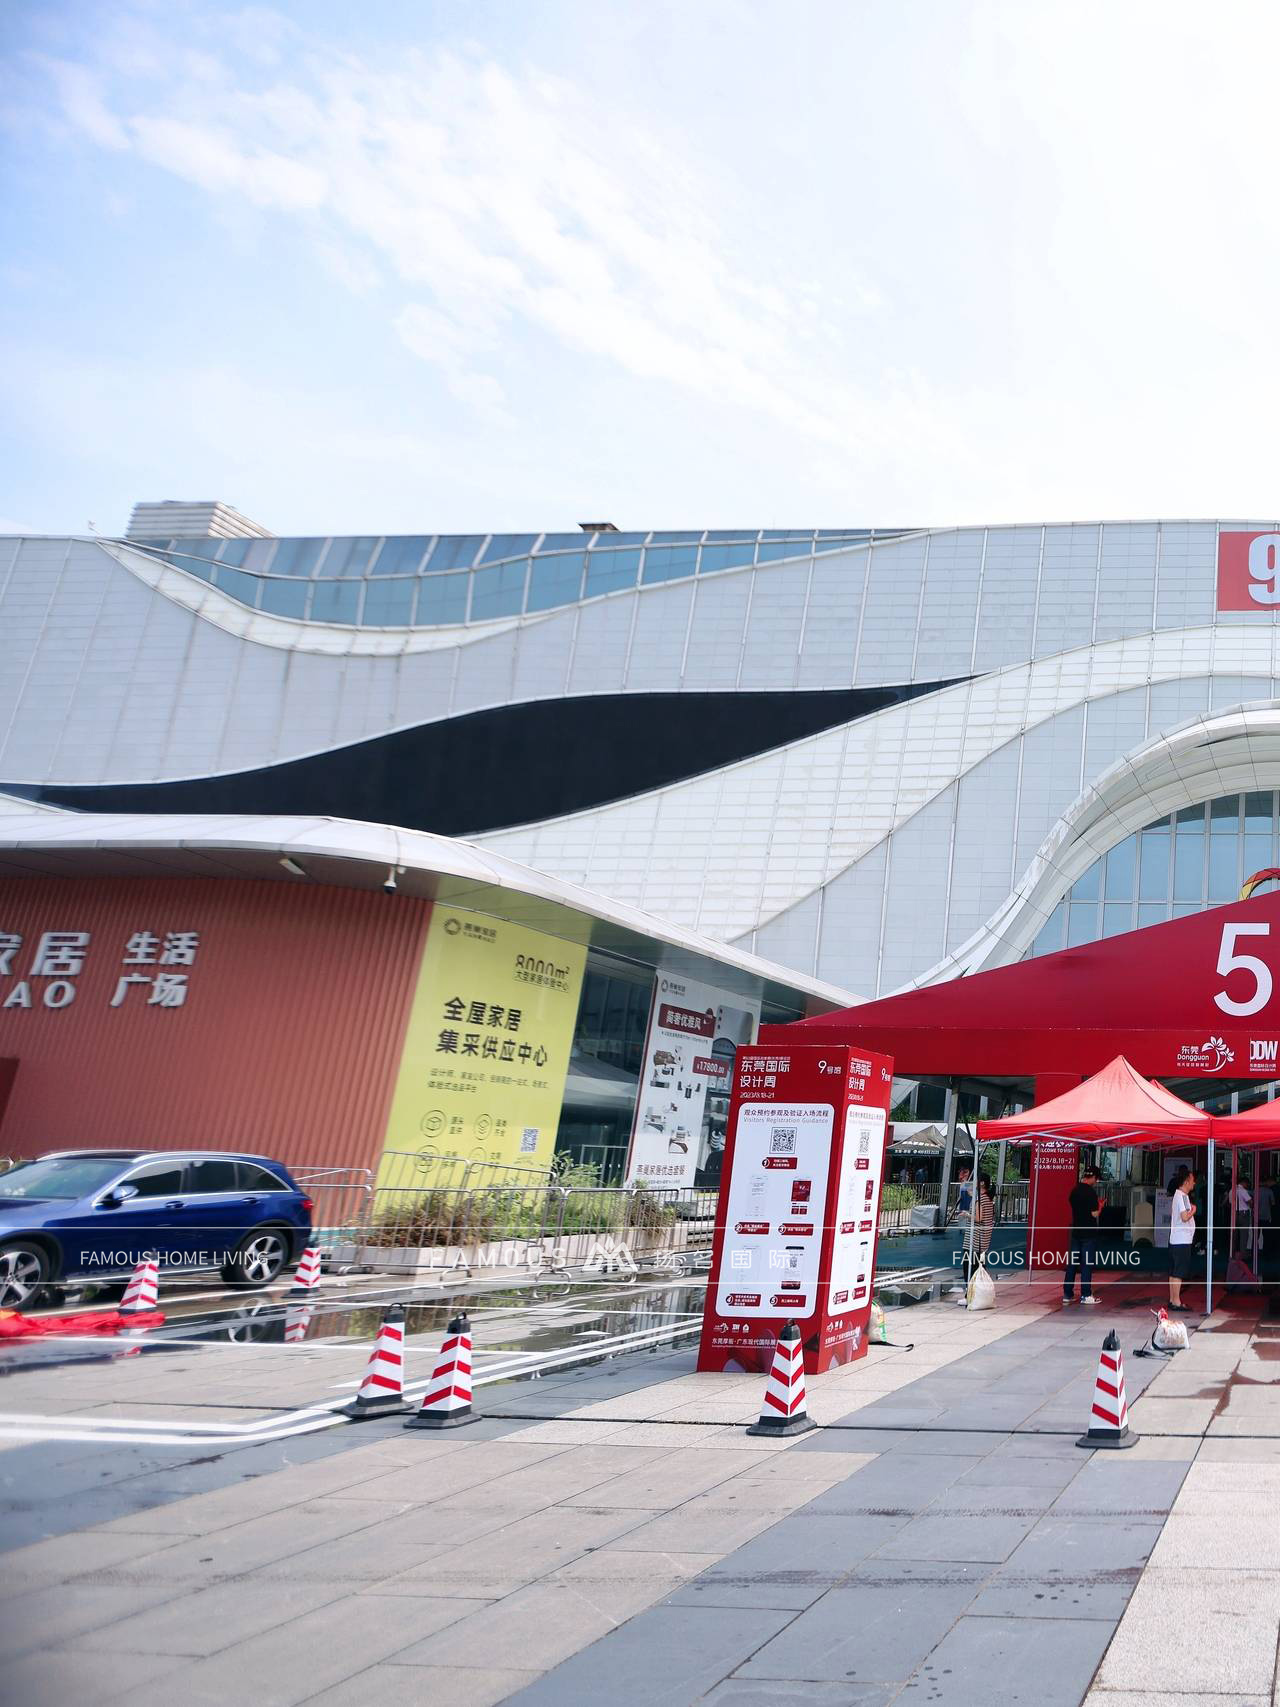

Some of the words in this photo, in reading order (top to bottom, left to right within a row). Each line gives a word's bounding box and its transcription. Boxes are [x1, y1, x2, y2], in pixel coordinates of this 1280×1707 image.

[122, 931, 200, 966] 生活
[1214, 923, 1273, 1016] 5
[3, 980, 76, 1008] AO
[110, 972, 189, 1008] 广场
[443, 996, 522, 1032] 全屋家居
[436, 1028, 548, 1067] 集采供应中心
[1181, 1045, 1199, 1054] 东莞
[740, 1060, 791, 1073] 东莞国际
[1177, 1054, 1209, 1062] Dongguan
[739, 1075, 777, 1088] 设计周
[743, 1109, 829, 1117] 观众预约参观及验证入场流程
[766, 1117, 800, 1125] Registration
